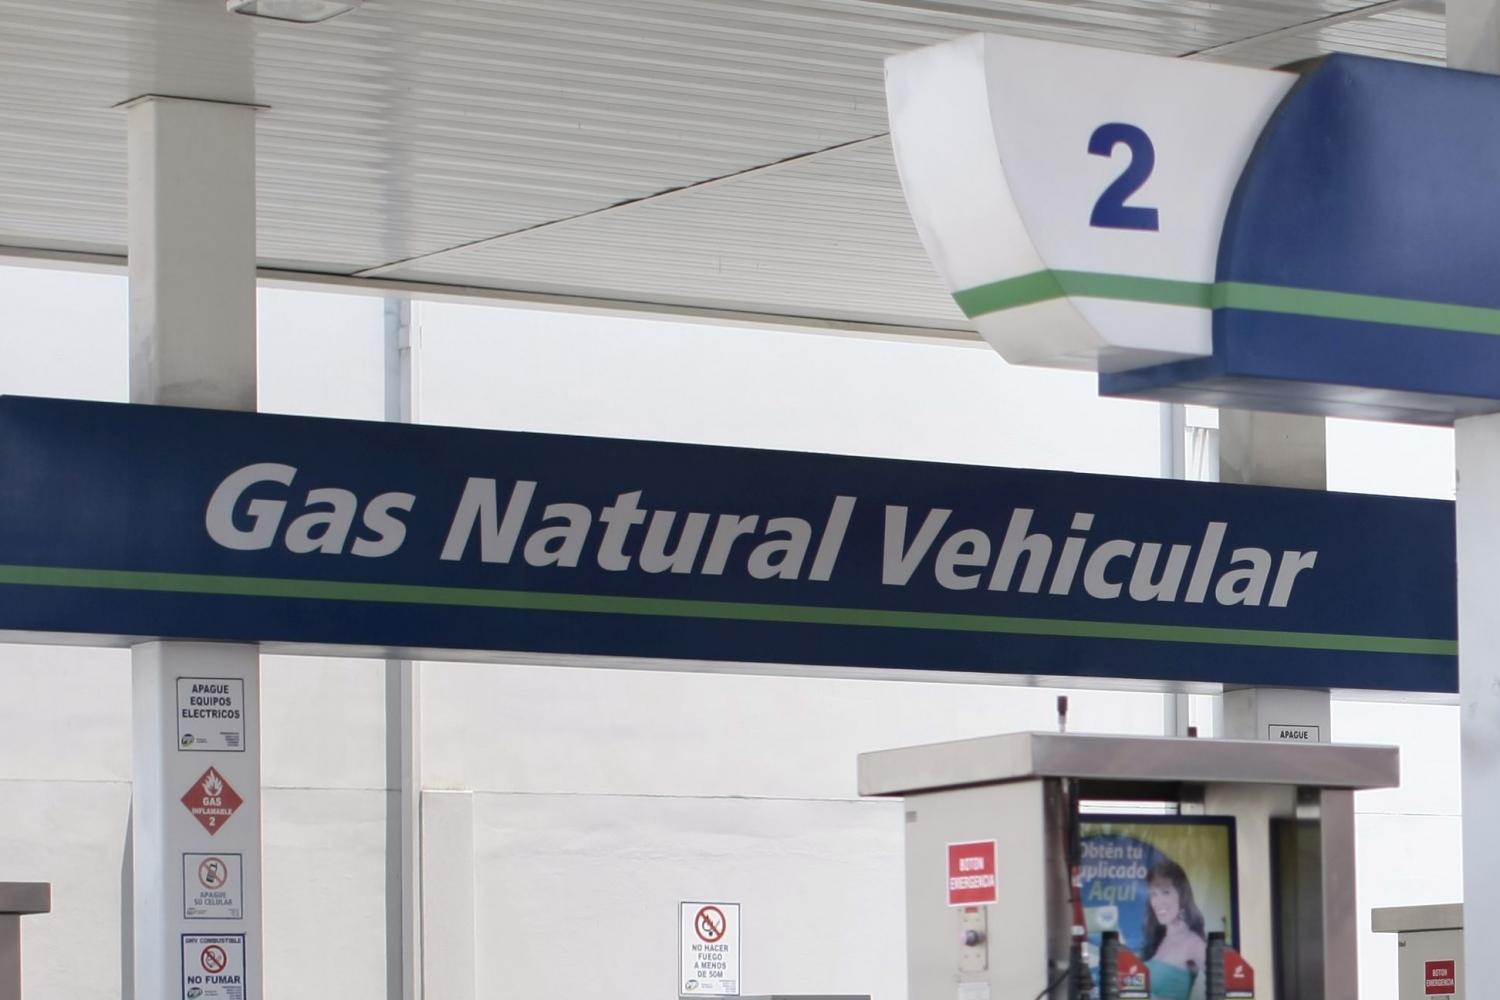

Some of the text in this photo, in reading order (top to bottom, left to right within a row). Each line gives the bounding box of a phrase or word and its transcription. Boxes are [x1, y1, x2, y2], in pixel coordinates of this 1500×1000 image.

[1087, 122, 1160, 232] 2
[206, 463, 1318, 608] Gas Natural Vehicular
[192, 684, 229, 694] APAGUE
[190, 697, 231, 706] EQUIPOS
[1280, 730, 1308, 739] APAGUE
[202, 797, 221, 807] GAS
[209, 817, 215, 826] 2
[187, 975, 241, 984] NO FUMAR
